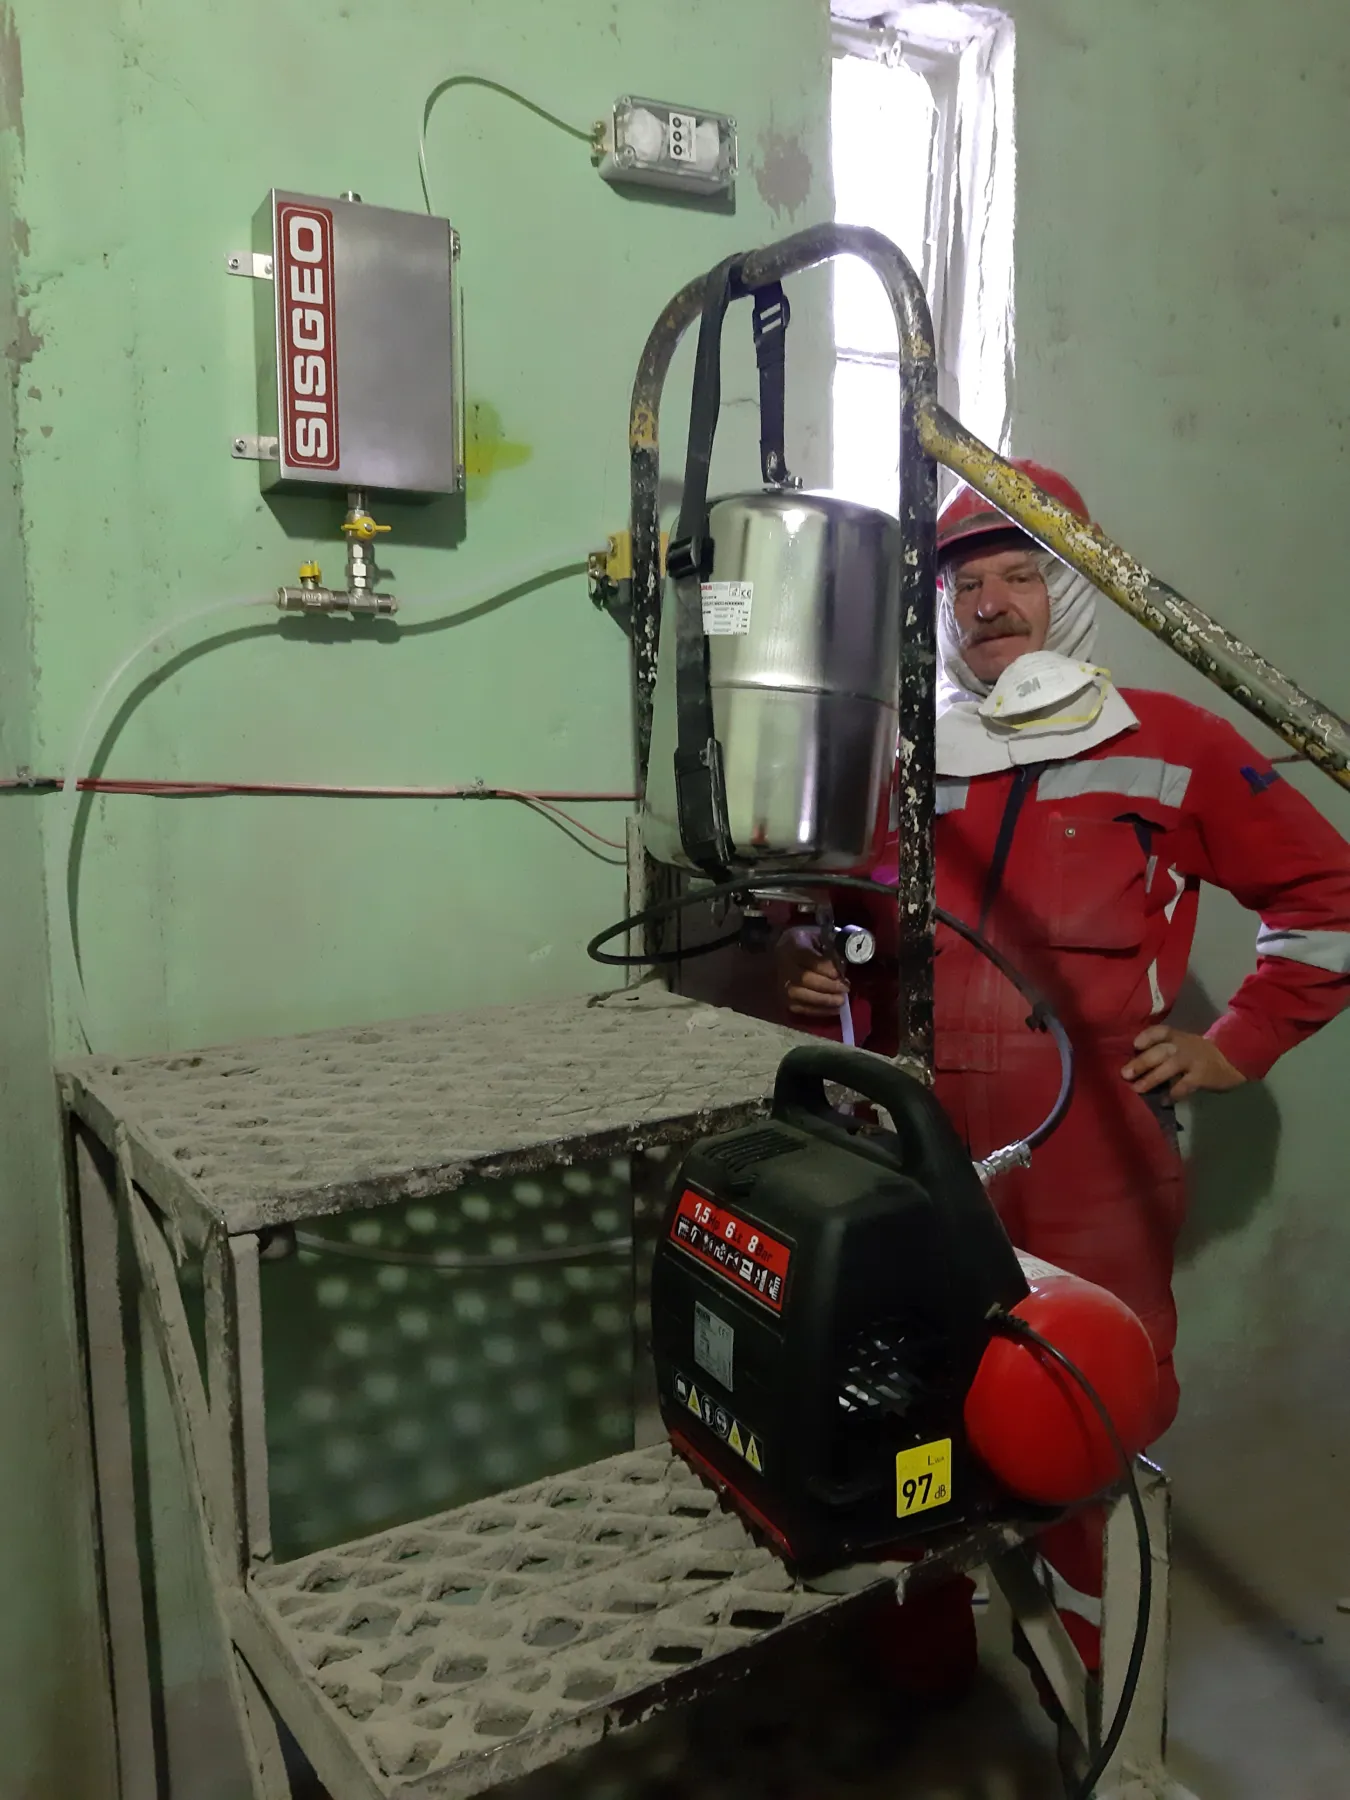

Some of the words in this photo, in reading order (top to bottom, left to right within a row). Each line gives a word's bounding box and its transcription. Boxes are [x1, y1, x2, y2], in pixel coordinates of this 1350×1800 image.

[290, 215, 328, 458] SISGEO
[1016, 677, 1041, 697] 3M
[902, 1472, 933, 1510] 97
[934, 1484, 946, 1499] dB
